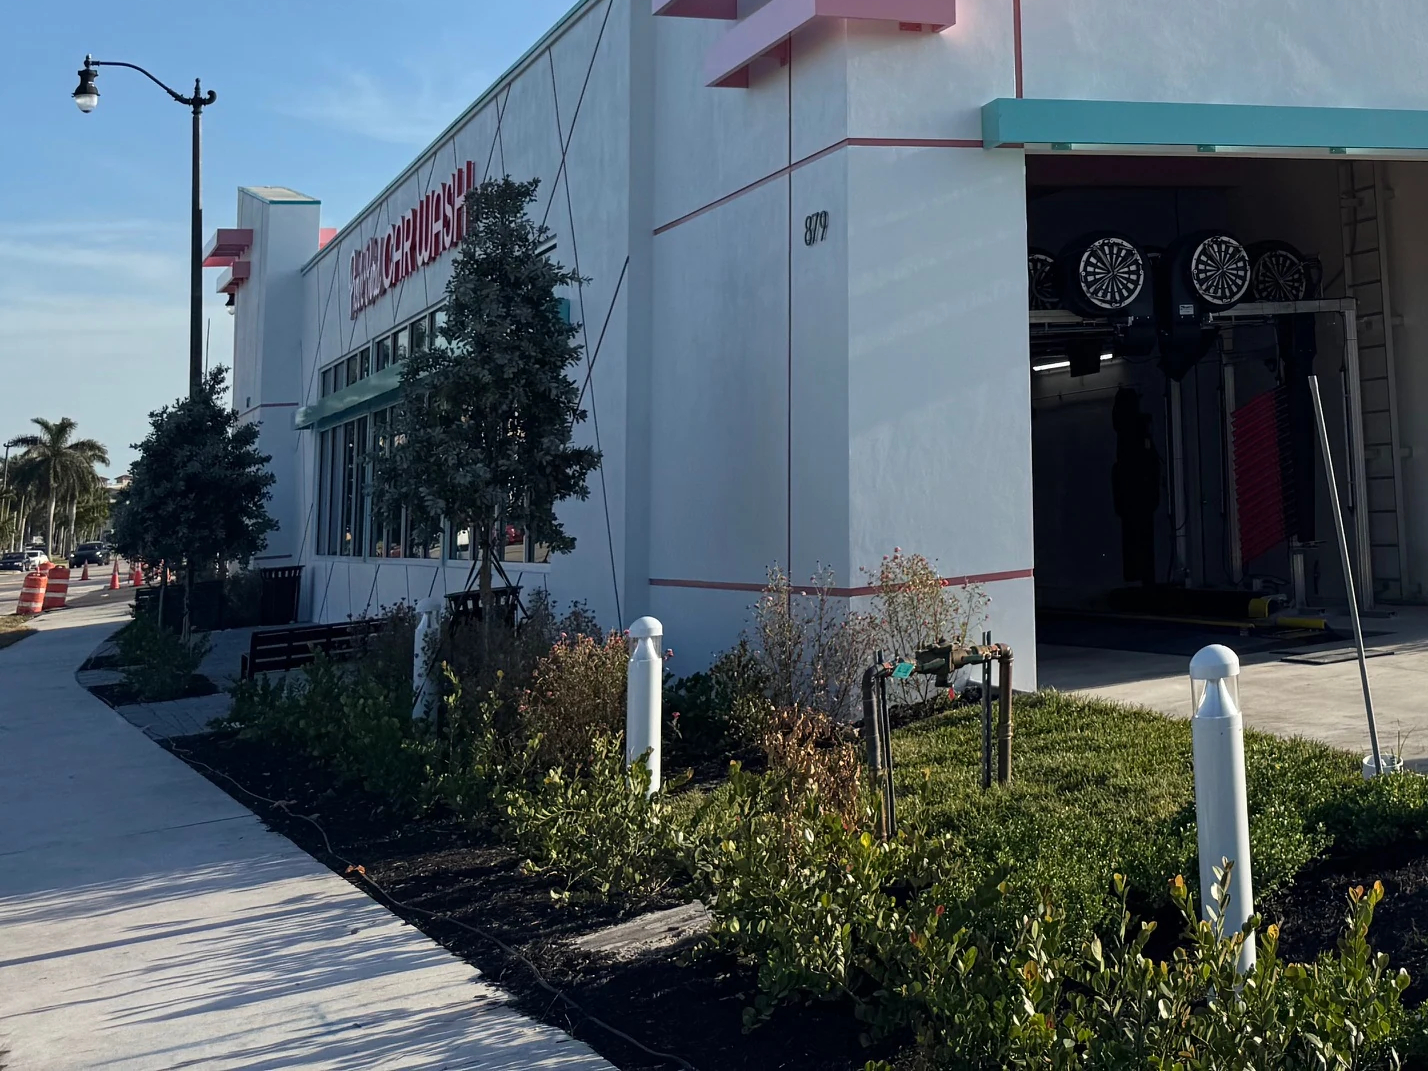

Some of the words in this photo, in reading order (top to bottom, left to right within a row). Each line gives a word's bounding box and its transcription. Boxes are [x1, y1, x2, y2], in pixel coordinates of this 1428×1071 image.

[382, 208, 416, 288] CAR
[416, 161, 475, 267] WASH
[804, 211, 829, 246] 879
